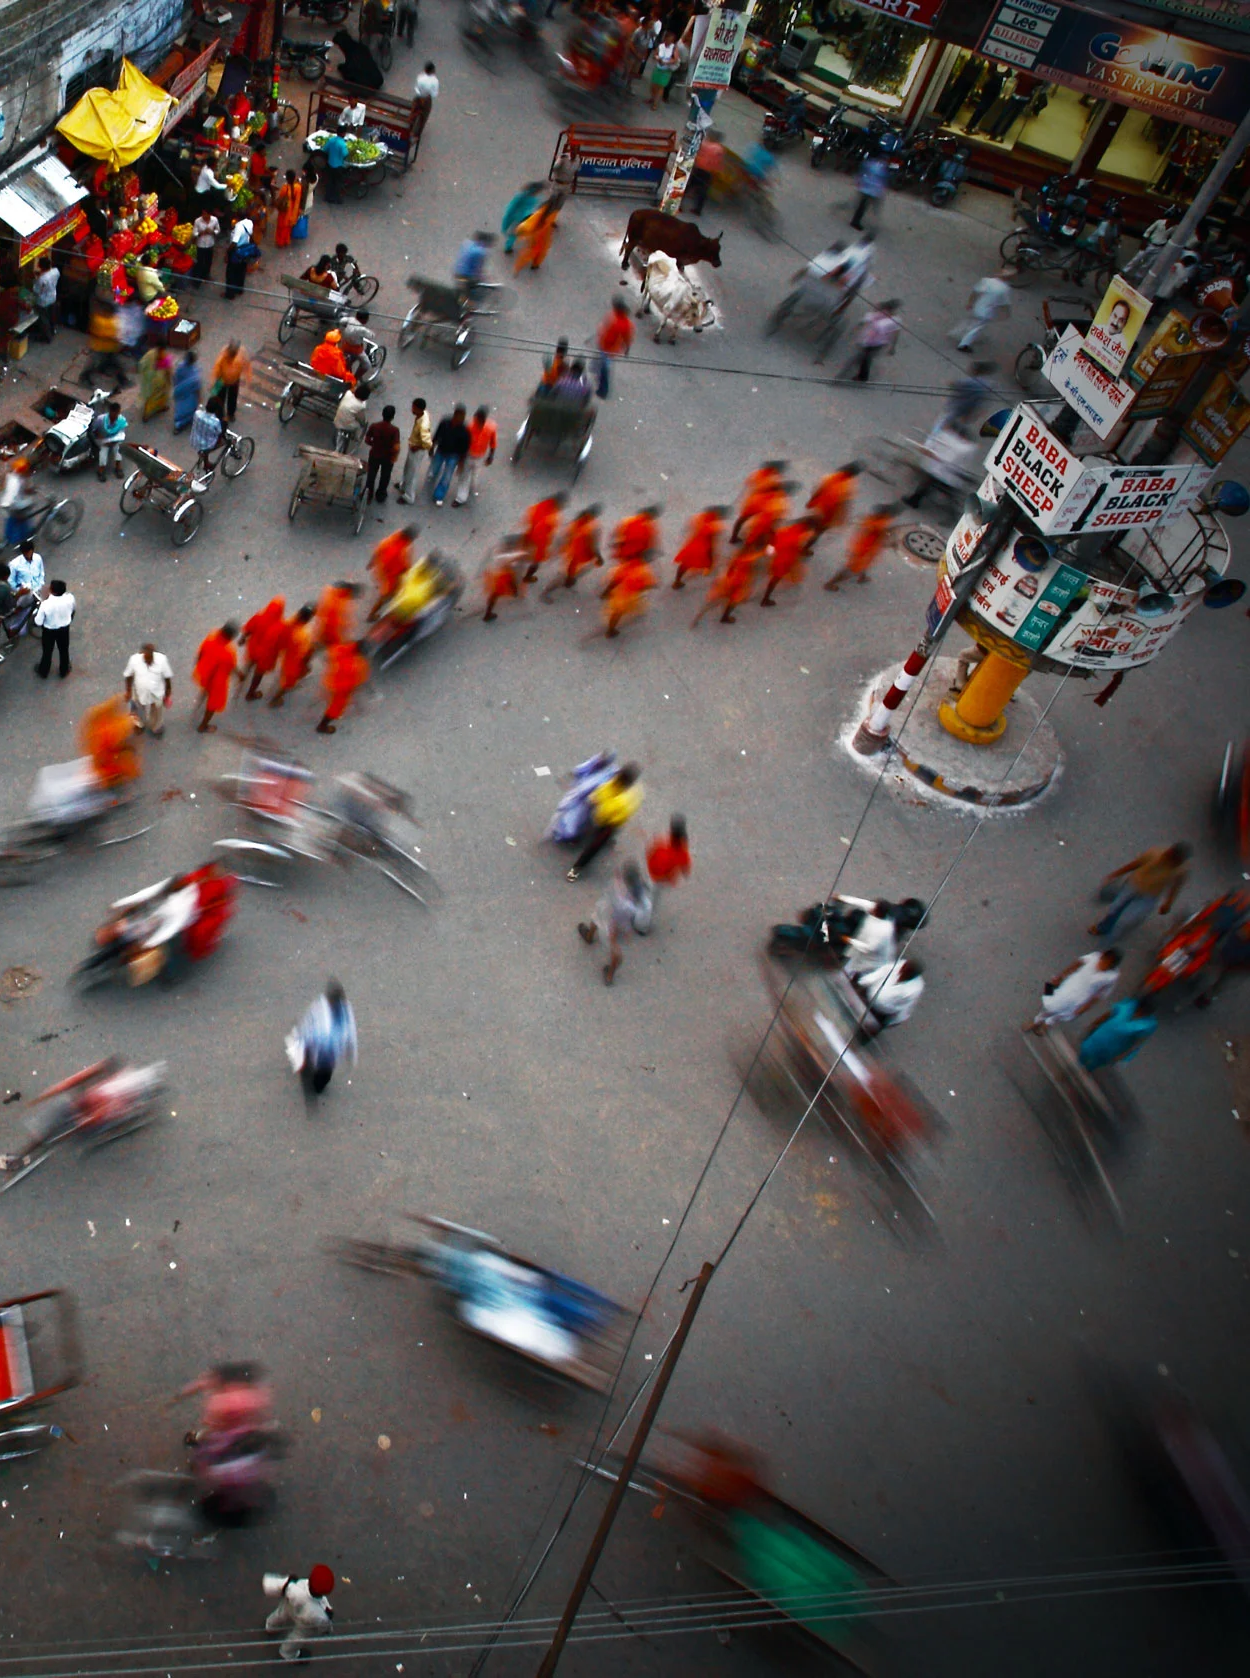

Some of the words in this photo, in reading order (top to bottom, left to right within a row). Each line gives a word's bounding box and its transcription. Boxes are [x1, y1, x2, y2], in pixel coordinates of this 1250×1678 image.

[1012, 12, 1037, 30] Lee
[1085, 61, 1206, 110] VASTRALAYA
[620, 156, 652, 169] पुलिस
[1090, 325, 1111, 349] राकेश
[1111, 339, 1126, 358] जैन
[1025, 425, 1069, 476] BABA
[1012, 438, 1065, 498] BLACK
[1002, 456, 1054, 513] SHEEP
[1119, 477, 1177, 494] BABA
[1103, 492, 1176, 511] BLACK
[1091, 509, 1162, 528] SHEEP
[982, 577, 997, 594] एवं
